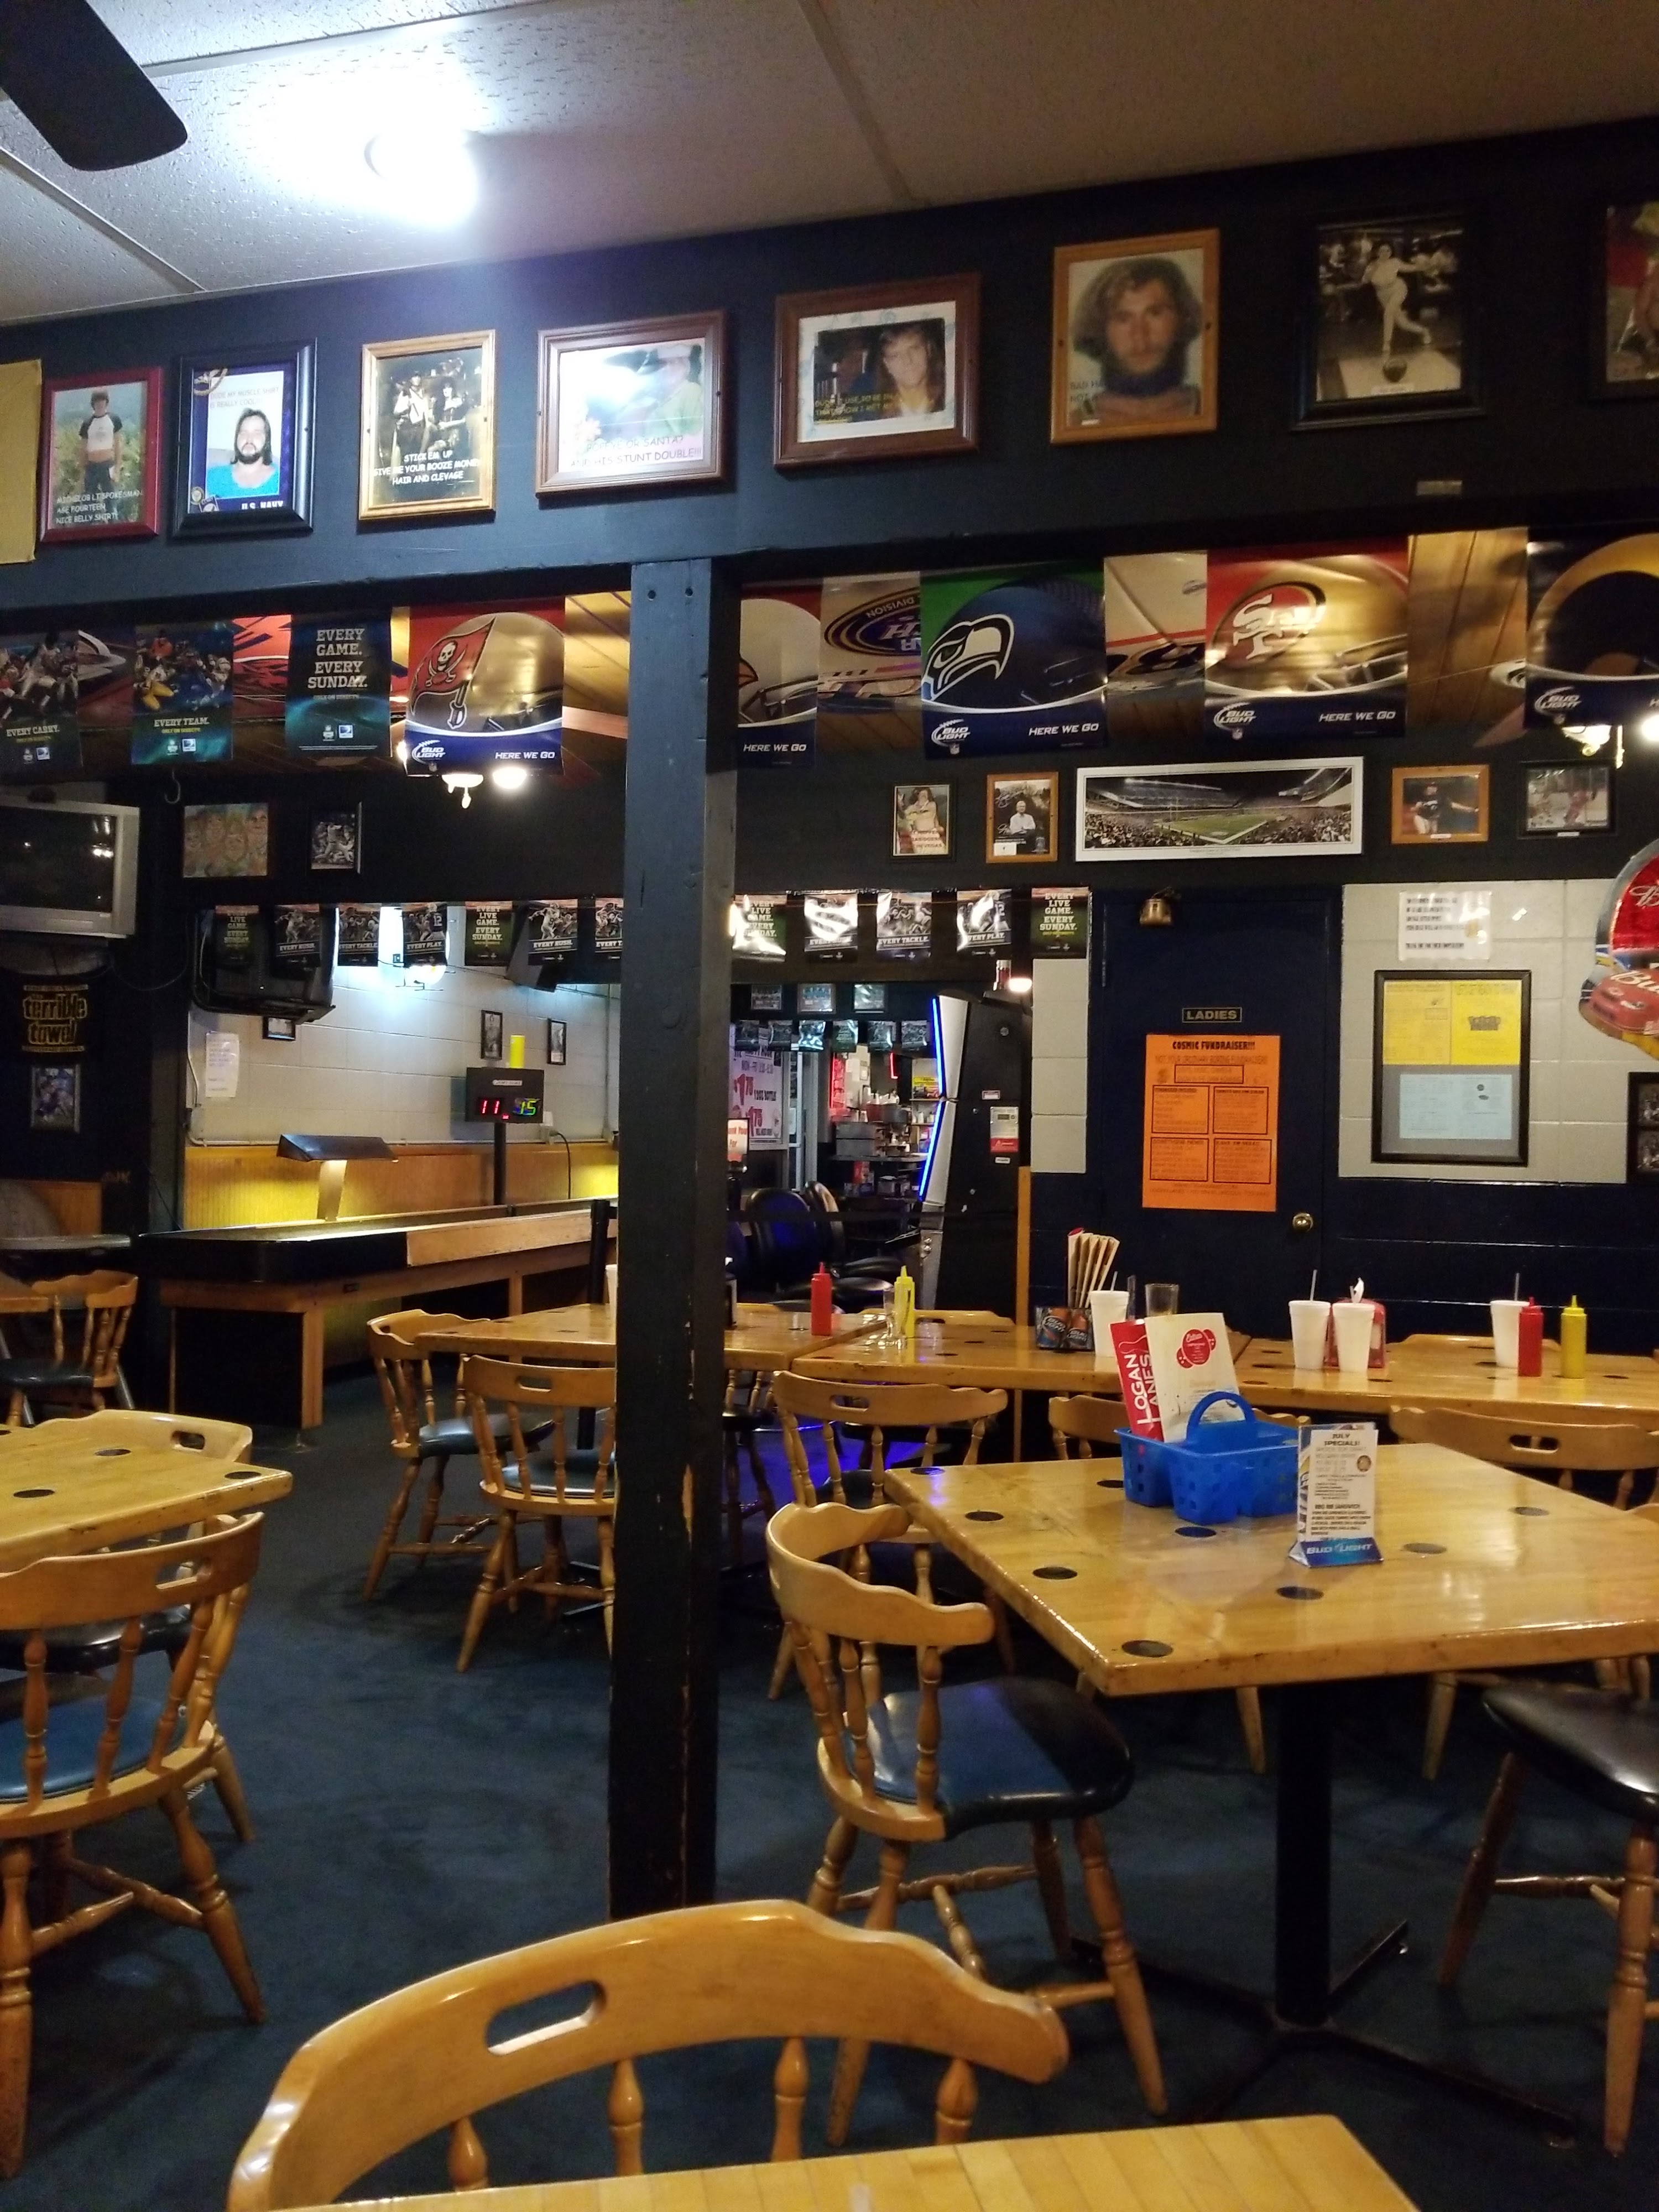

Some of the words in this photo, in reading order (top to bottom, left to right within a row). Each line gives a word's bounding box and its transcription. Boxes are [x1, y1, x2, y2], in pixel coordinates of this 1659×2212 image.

[625, 440, 640, 448] OR
[643, 435, 684, 447] SANTA?
[404, 453, 426, 462] STICK
[427, 452, 440, 461] EM
[442, 450, 453, 458] UP
[616, 452, 653, 463] STUNT
[405, 463, 426, 473] YOUR
[427, 460, 452, 471] BOOZE
[392, 476, 411, 486] HAIR
[413, 473, 430, 484] AND
[430, 470, 463, 481] CLEVAGE
[71, 503, 106, 513] FOURTEEN
[74, 514, 93, 523] BELLY
[316, 628, 366, 642] EVERY
[316, 643, 362, 656] GAME.
[314, 661, 364, 674] EVERY
[307, 675, 368, 689] SUNDAY.
[1541, 700, 1582, 709] LIGHT
[1548, 695, 1580, 703] BUD
[154, 718, 183, 727] EVERY
[1219, 715, 1258, 723] LIGHT
[1319, 712, 1353, 723] HERE
[1355, 711, 1374, 721] WE
[1376, 710, 1397, 719] GO
[6, 727, 32, 737] EVERY
[1028, 725, 1060, 737] HERE
[1061, 724, 1079, 734] WE
[1081, 722, 1099, 733] GO
[937, 732, 971, 740] LIGHT
[743, 744, 771, 752] HERE
[773, 744, 789, 752] WE
[791, 743, 807, 752] GO
[1186, 1009, 1238, 1021] LADIES
[1172, 1041, 1199, 1050] COSMIC
[520, 1100, 536, 1115] 15
[1046, 1317, 1066, 1328] BUD
[1124, 1354, 1154, 1425] LOGAN
[1306, 1547, 1333, 1555] BUD
[1339, 1543, 1374, 1552] LIGHT
